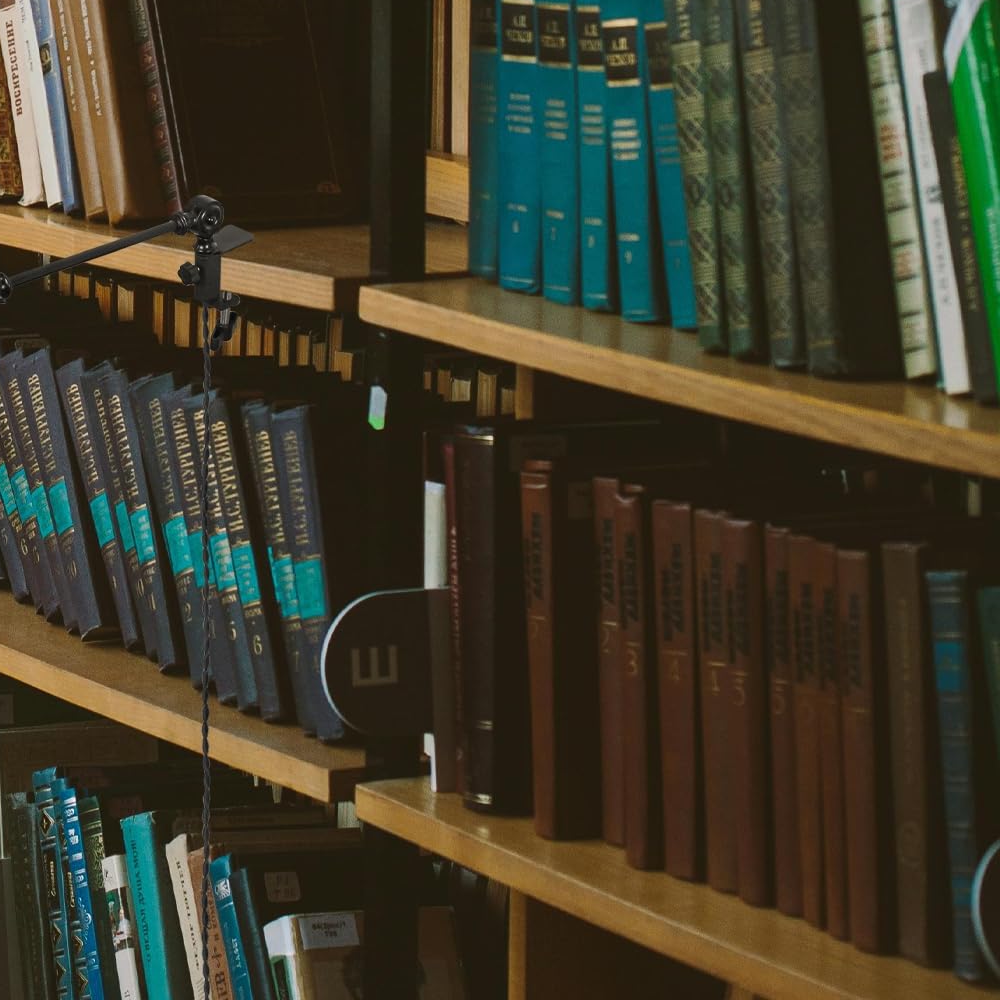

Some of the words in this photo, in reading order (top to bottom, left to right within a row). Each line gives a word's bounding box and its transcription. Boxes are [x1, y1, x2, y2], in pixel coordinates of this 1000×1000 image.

[5, 20, 22, 116] ВОСКРЕСЕНИЕ
[27, 373, 57, 473] И.С.ТУРГЕНЕВ
[66, 383, 99, 485] И.С.ТУРГЕНЕВ
[211, 420, 245, 532] И.С.ТУРГЕНЕВ
[20, 540, 28, 556] 6
[252, 634, 263, 655] 6
[351, 644, 399, 687] Ш
